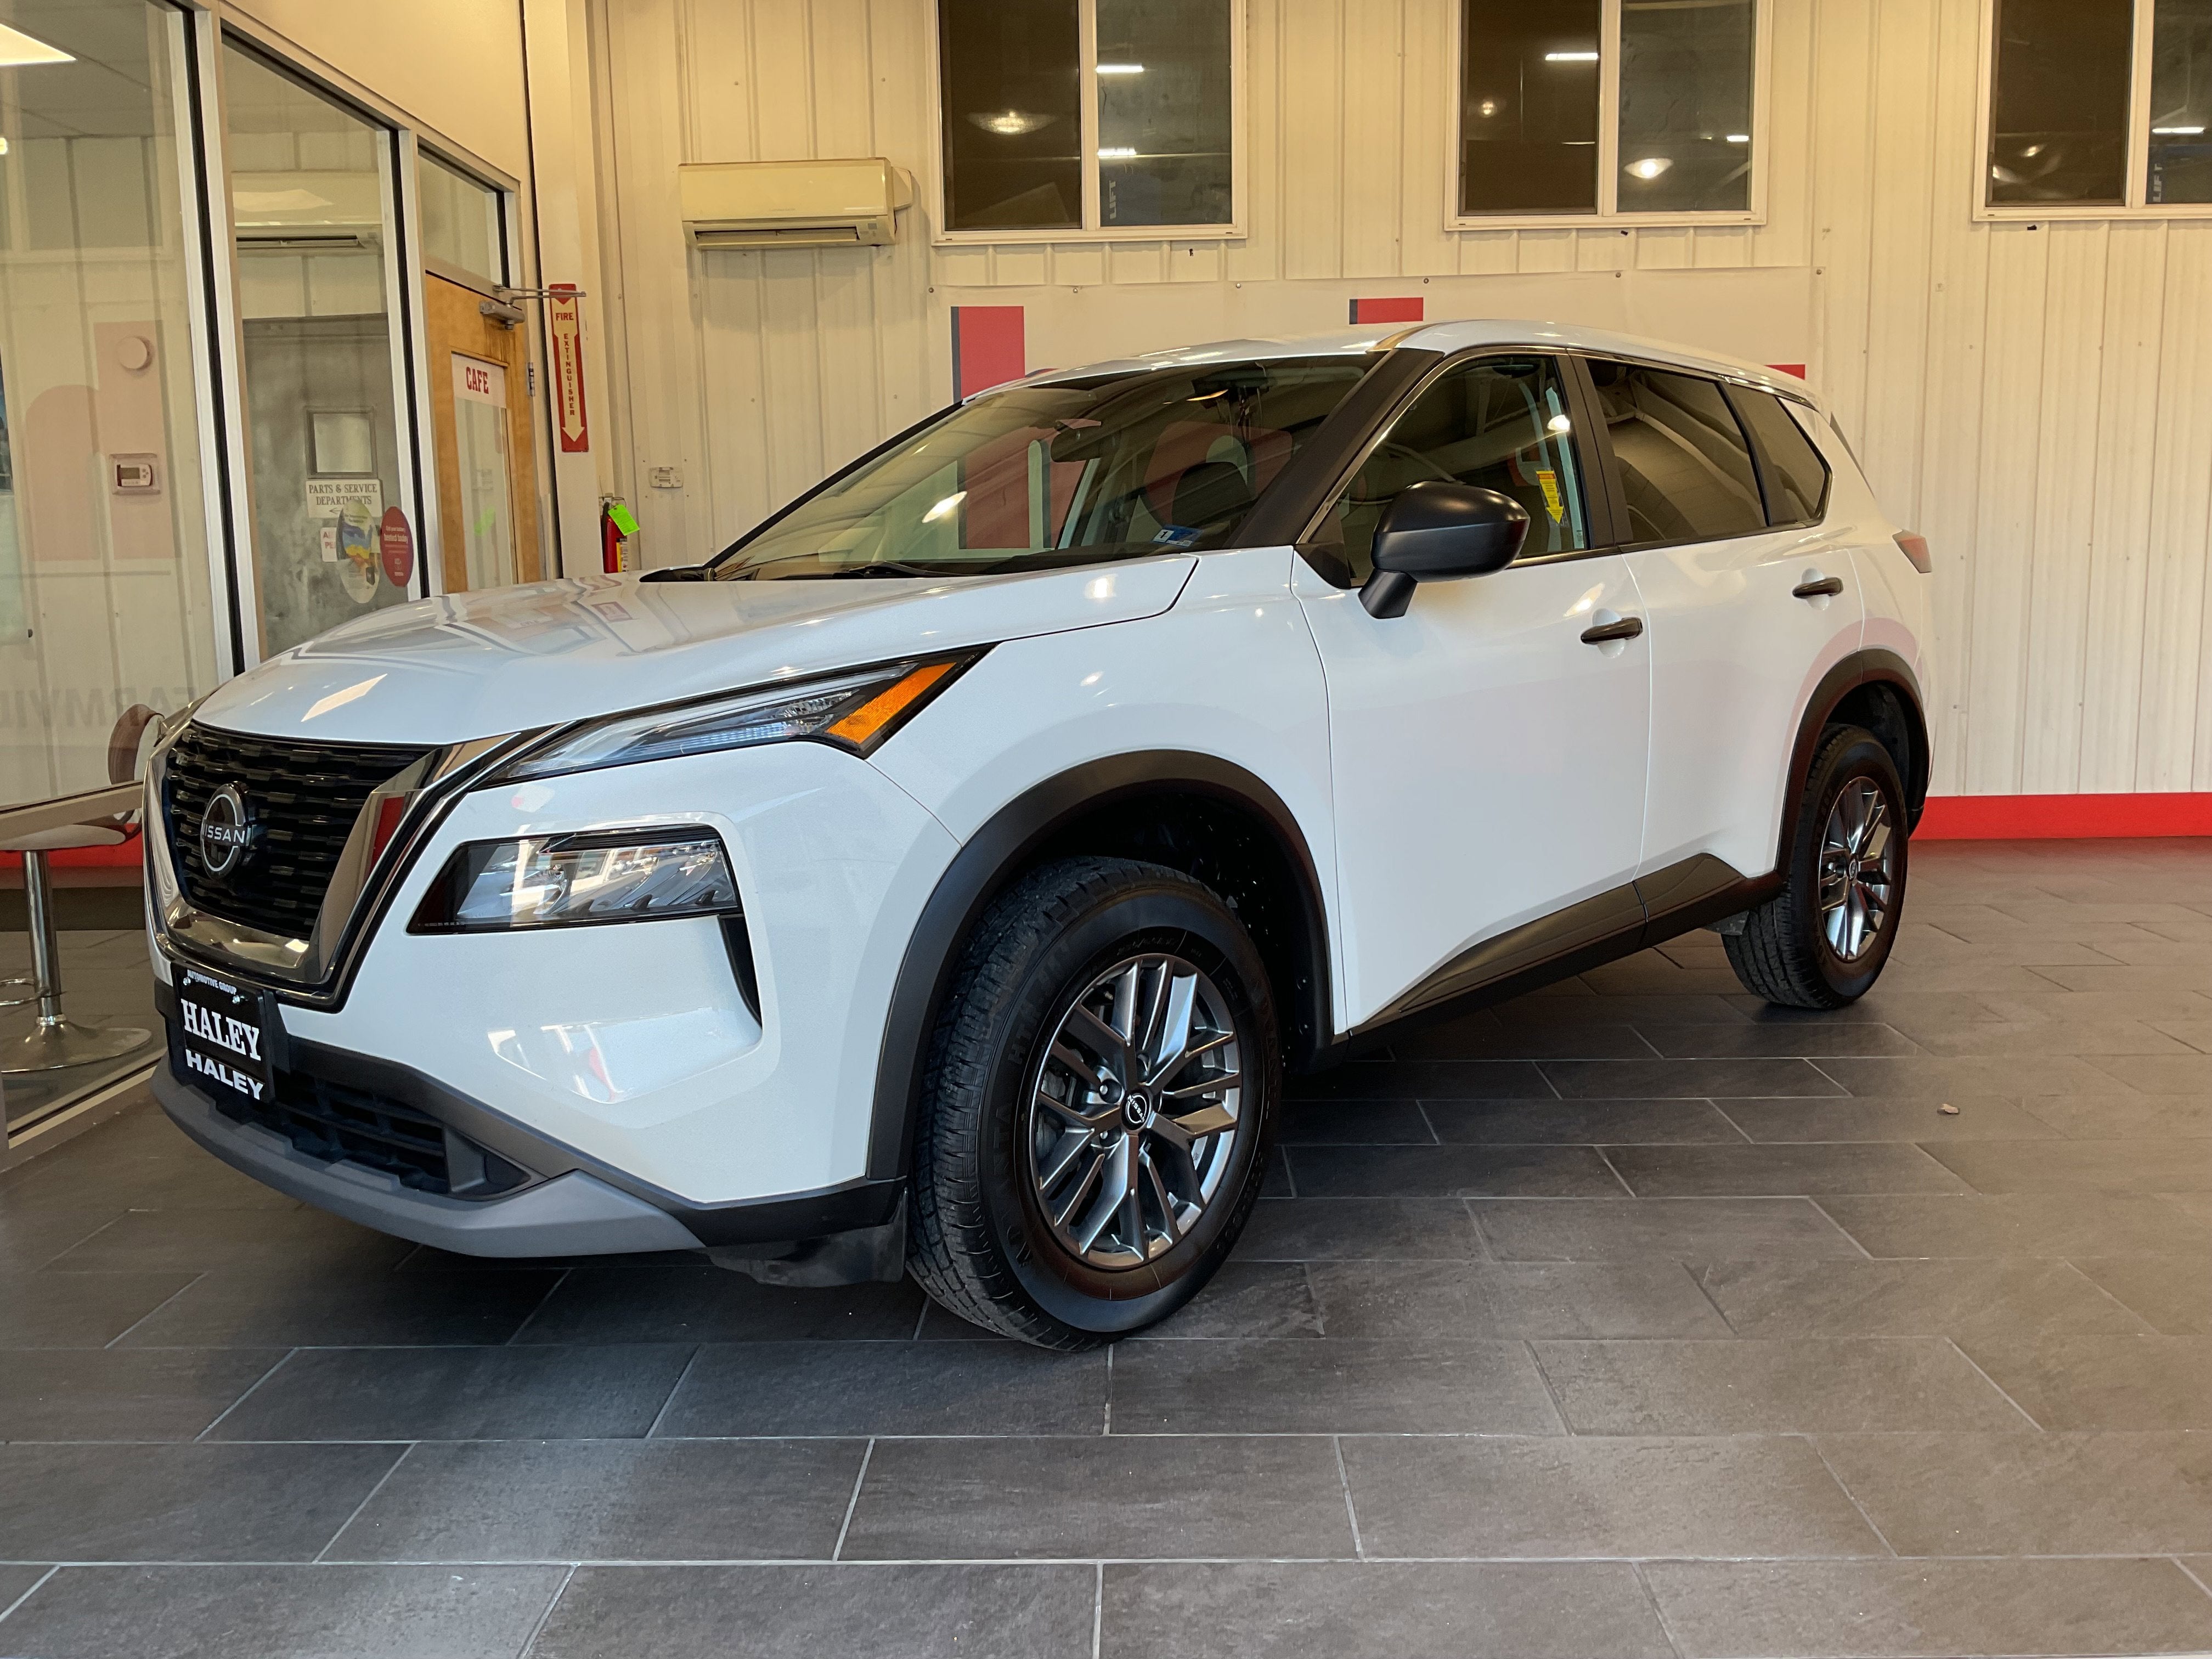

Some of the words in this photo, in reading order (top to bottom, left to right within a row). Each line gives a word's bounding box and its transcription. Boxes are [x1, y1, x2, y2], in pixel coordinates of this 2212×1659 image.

[555, 312, 574, 321] FIRE
[466, 366, 489, 394] CAFE
[563, 333, 575, 416] EXTINGUISHER
[308, 484, 334, 494] PARTS
[335, 484, 342, 493] &
[344, 483, 377, 493] SERVICE
[202, 823, 246, 844] ISSAN
[187, 969, 219, 989] AUTOMOTIVE
[218, 981, 237, 995] GROUP
[180, 998, 262, 1062] HALEY
[185, 1048, 264, 1101] HALEY
[1127, 1094, 1145, 1123] NISSAN
